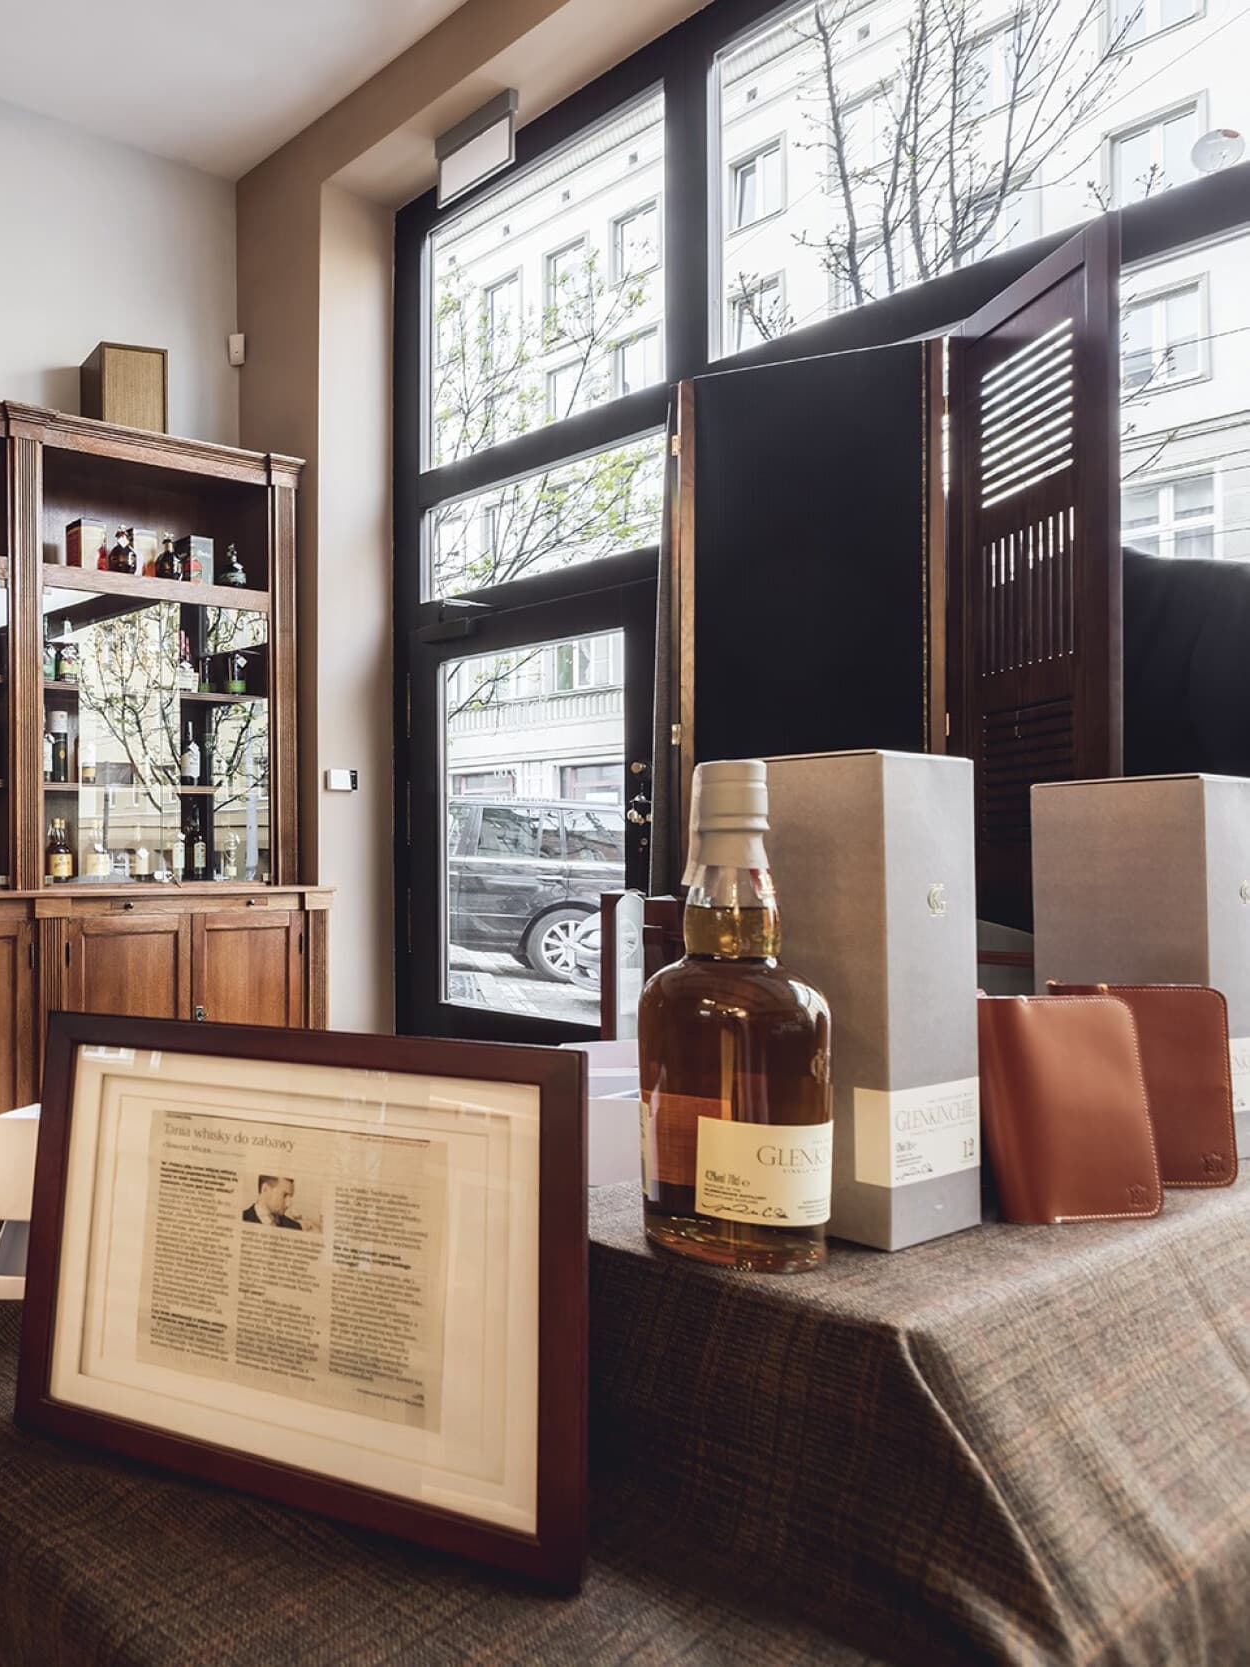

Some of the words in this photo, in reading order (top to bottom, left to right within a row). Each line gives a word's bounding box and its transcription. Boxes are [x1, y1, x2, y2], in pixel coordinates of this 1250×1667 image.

[194, 1126, 232, 1146] whisky
[234, 1132, 249, 1145] do
[251, 1135, 296, 1153] zabawy
[756, 1144, 830, 1168] GLENK
